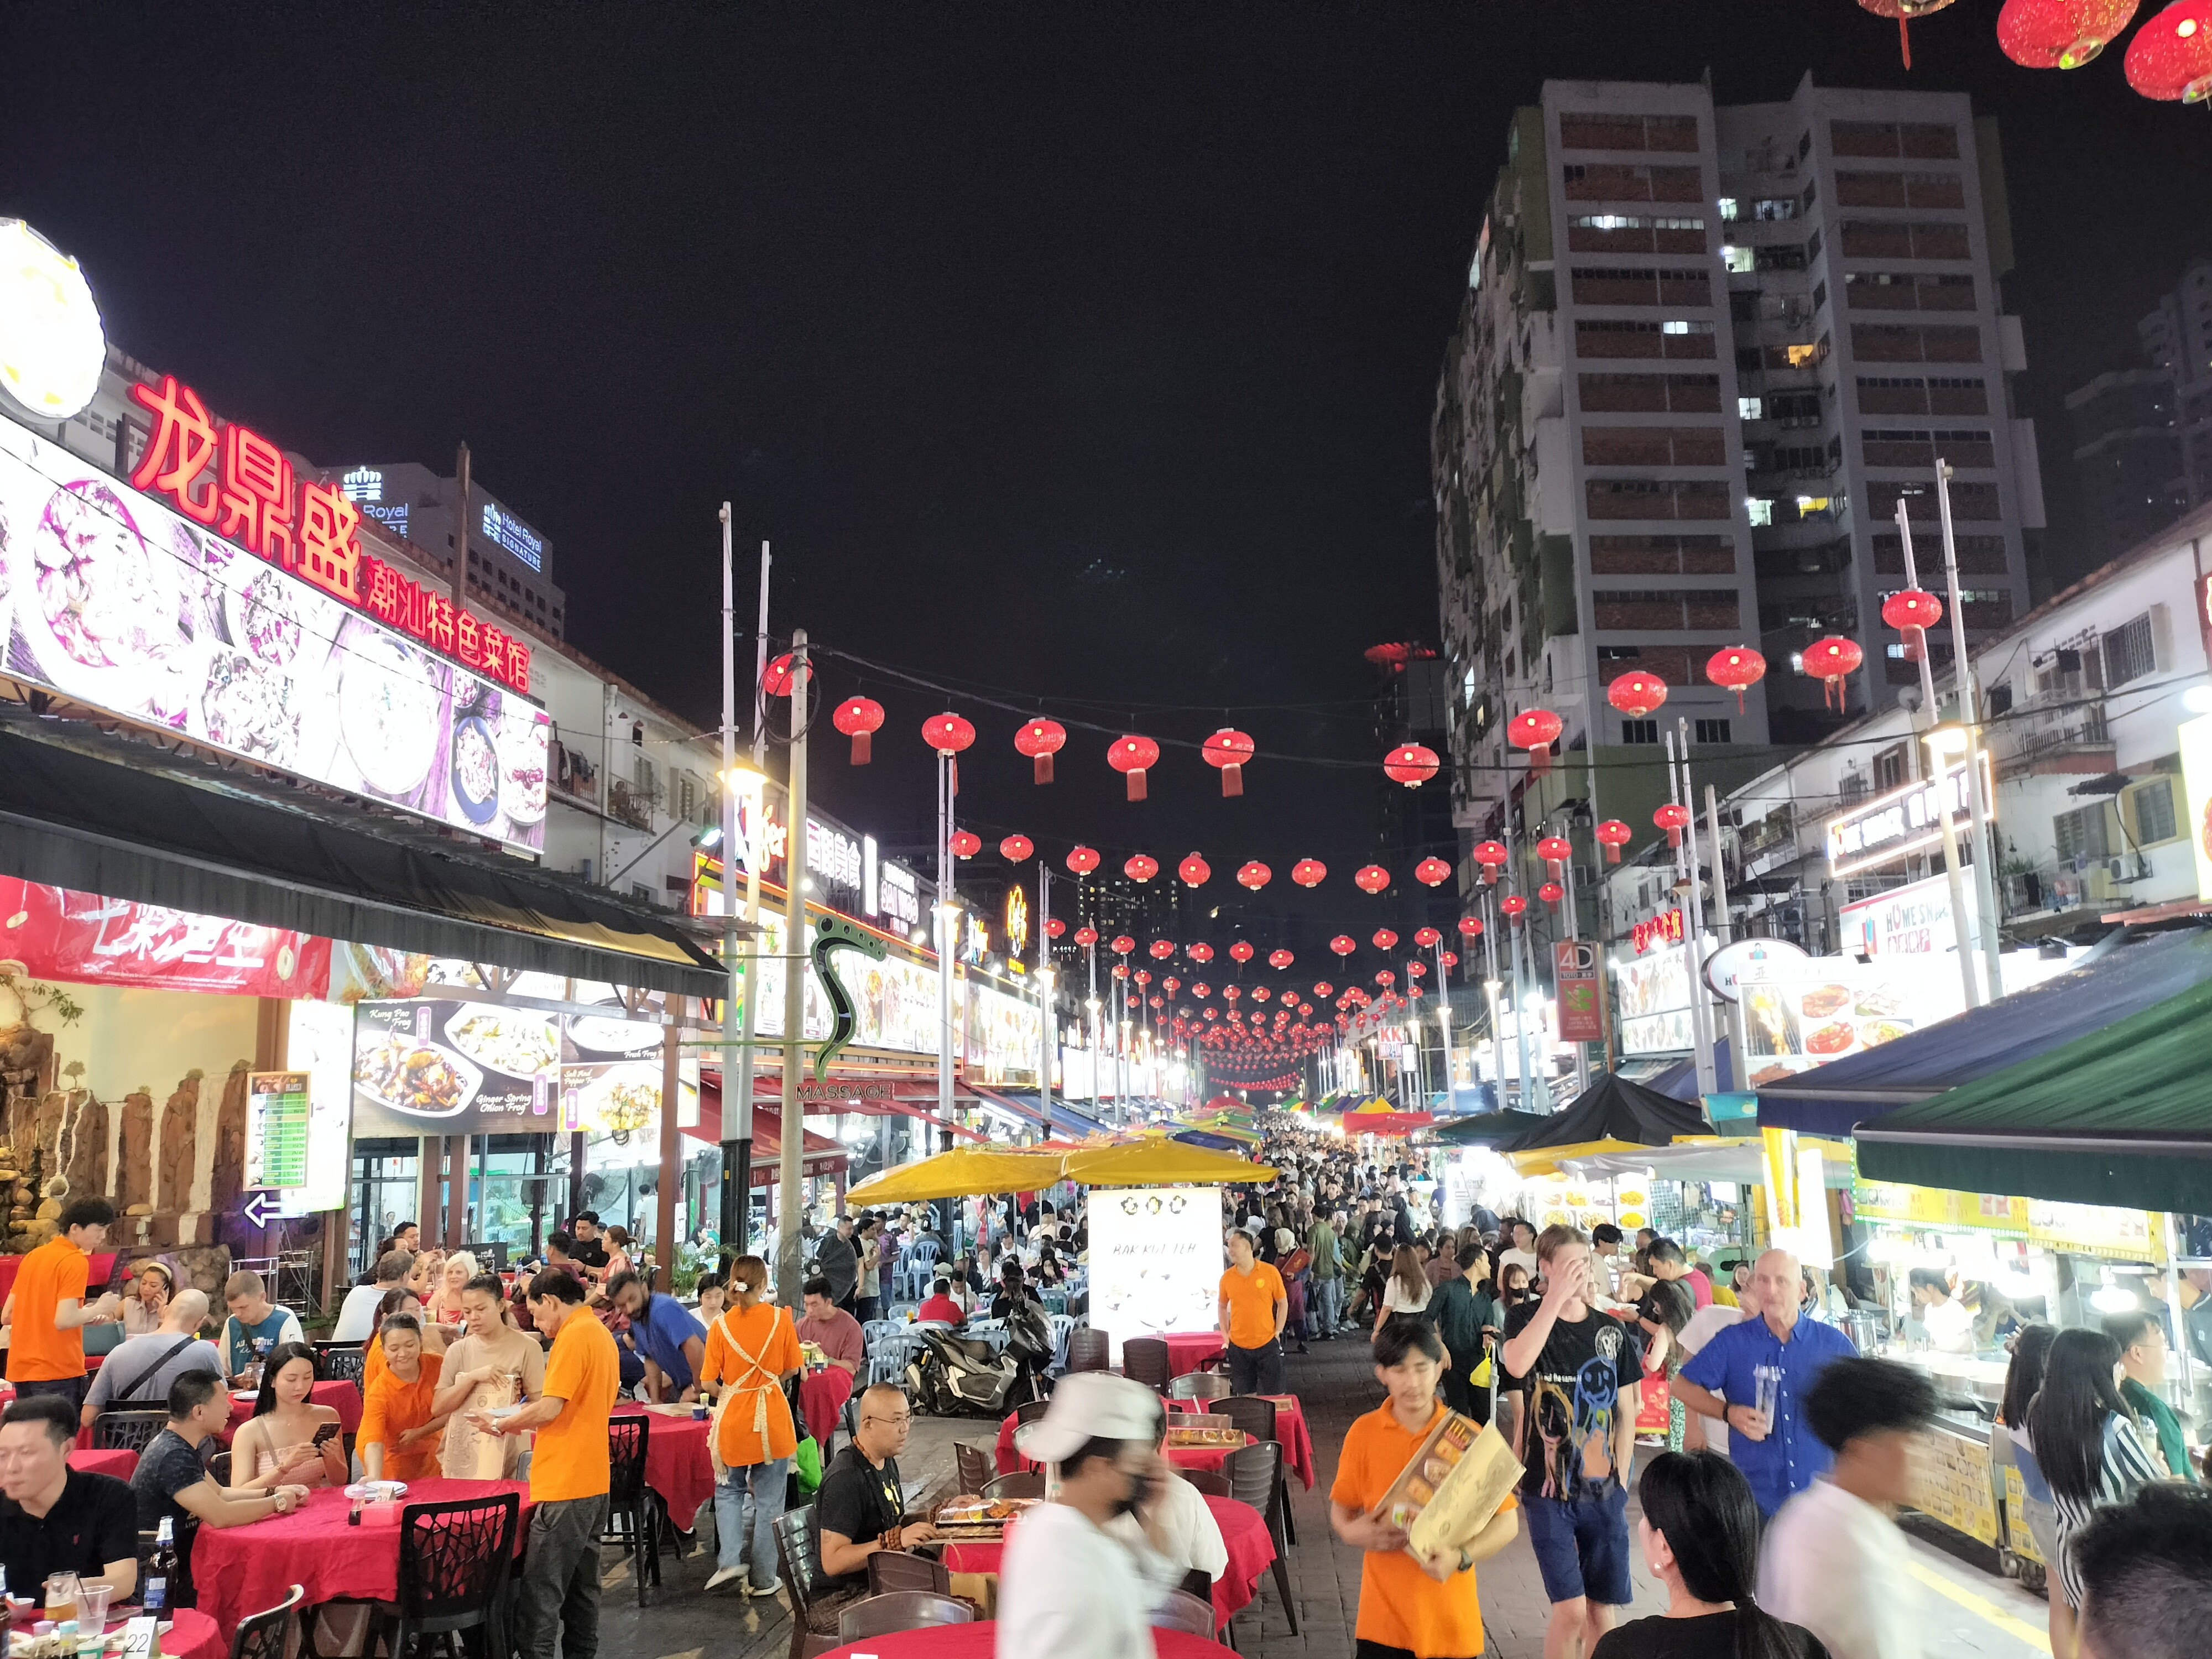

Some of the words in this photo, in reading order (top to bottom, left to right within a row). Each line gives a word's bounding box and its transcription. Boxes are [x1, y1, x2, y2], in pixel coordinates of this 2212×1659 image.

[133, 375, 362, 606] 龙鼎盛
[363, 503, 409, 520] Royal
[502, 512, 521, 536] Hotel
[522, 528, 541, 553] Royal
[502, 534, 541, 568] SIGNATURE
[366, 555, 530, 693] 潮汕特色菜馆
[1559, 945, 1594, 969] 4D
[369, 1009, 392, 1021] Kung
[394, 1009, 410, 1018] Pao
[392, 1017, 412, 1030] Frog
[1380, 1027, 1402, 1042] KK
[642, 1050, 657, 1060] Frog
[795, 1084, 891, 1100] MASSAGE
[476, 1094, 503, 1108] Ginger
[504, 1093, 533, 1107] Spring
[479, 1104, 505, 1113] Onion
[505, 1103, 526, 1115] Frog
[1113, 1244, 1139, 1255] BAK
[125, 1633, 149, 1653] 22
